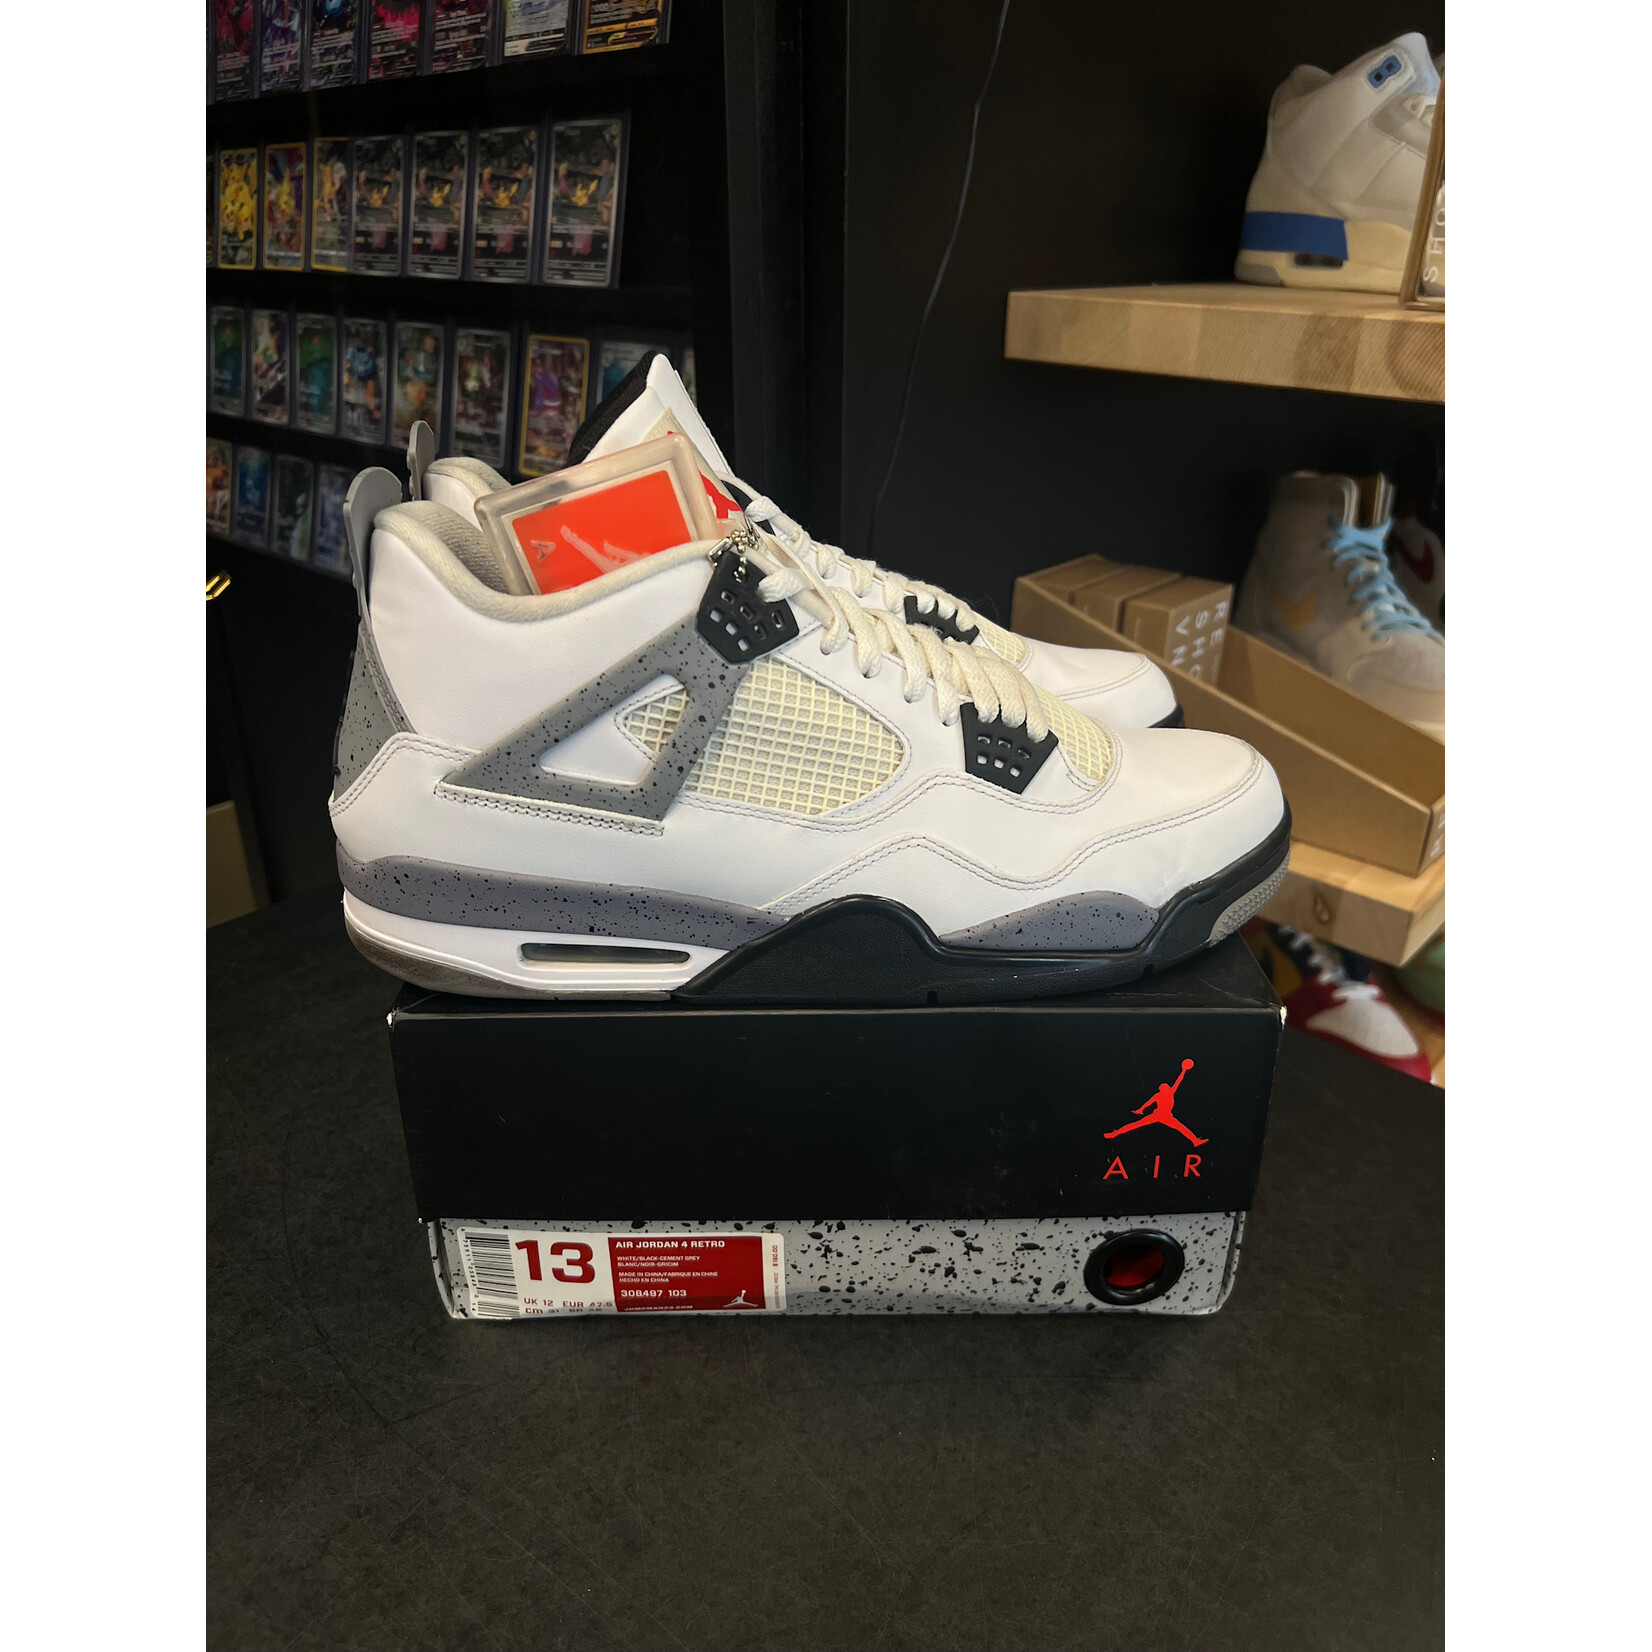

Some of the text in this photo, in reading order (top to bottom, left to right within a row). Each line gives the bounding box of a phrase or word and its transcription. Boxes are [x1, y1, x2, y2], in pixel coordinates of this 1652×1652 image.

[1103, 1154, 1202, 1180] AIR
[615, 1241, 633, 1249] AIR
[636, 1241, 679, 1249] JORDAN
[690, 1240, 725, 1248] RETRO
[515, 1240, 595, 1283] 13
[620, 1289, 687, 1298] 308497 103
[524, 1297, 538, 1306] UK
[543, 1299, 554, 1307] 12
